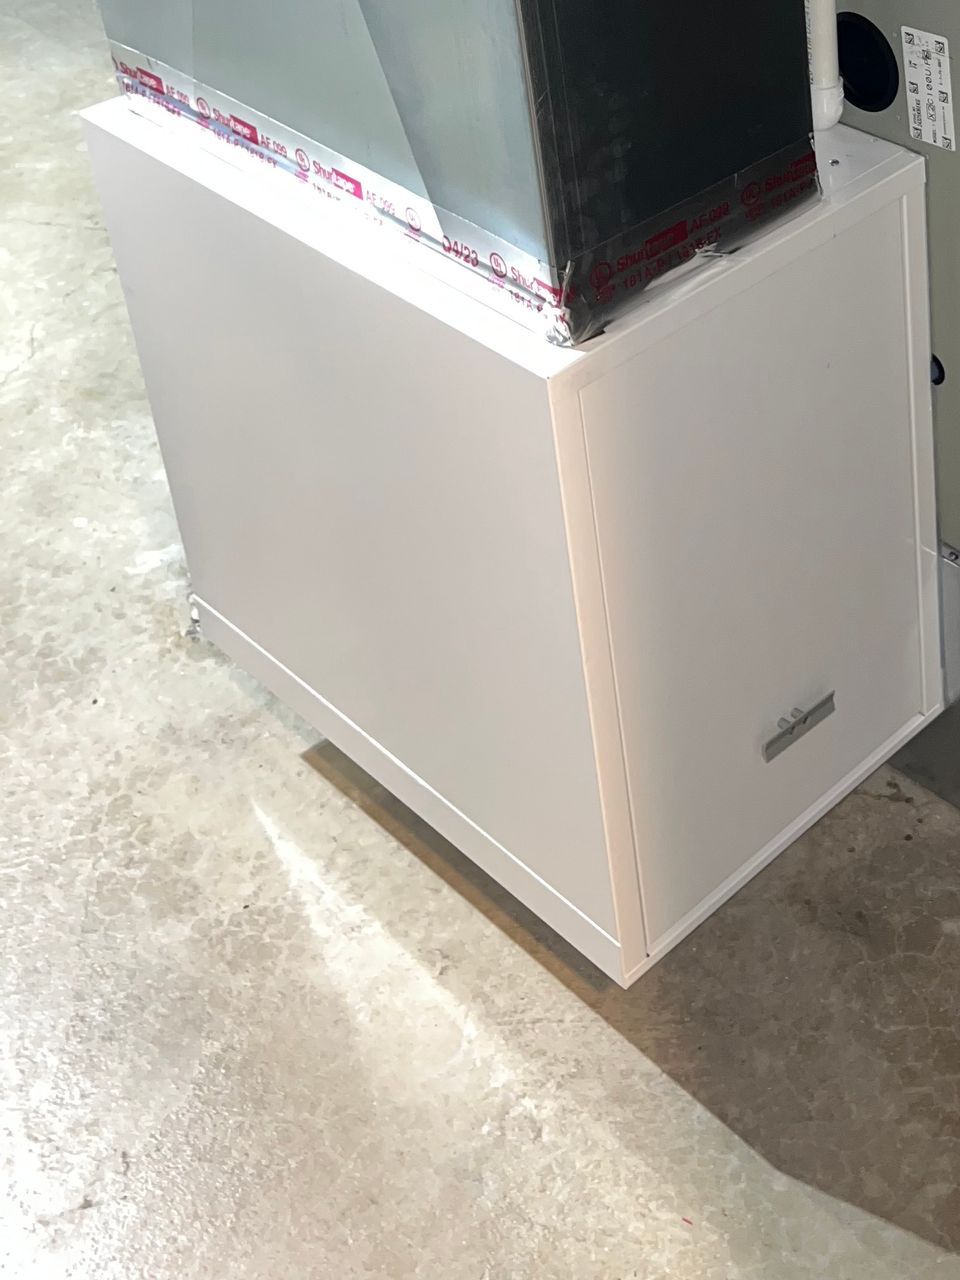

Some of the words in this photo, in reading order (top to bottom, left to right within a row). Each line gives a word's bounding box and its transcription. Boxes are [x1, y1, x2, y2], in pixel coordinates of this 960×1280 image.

[212, 108, 259, 146] Shurtape
[260, 133, 273, 149] AF
[272, 139, 288, 158] 099
[312, 159, 363, 201] Shurtape
[441, 234, 480, 268] Q4/23
